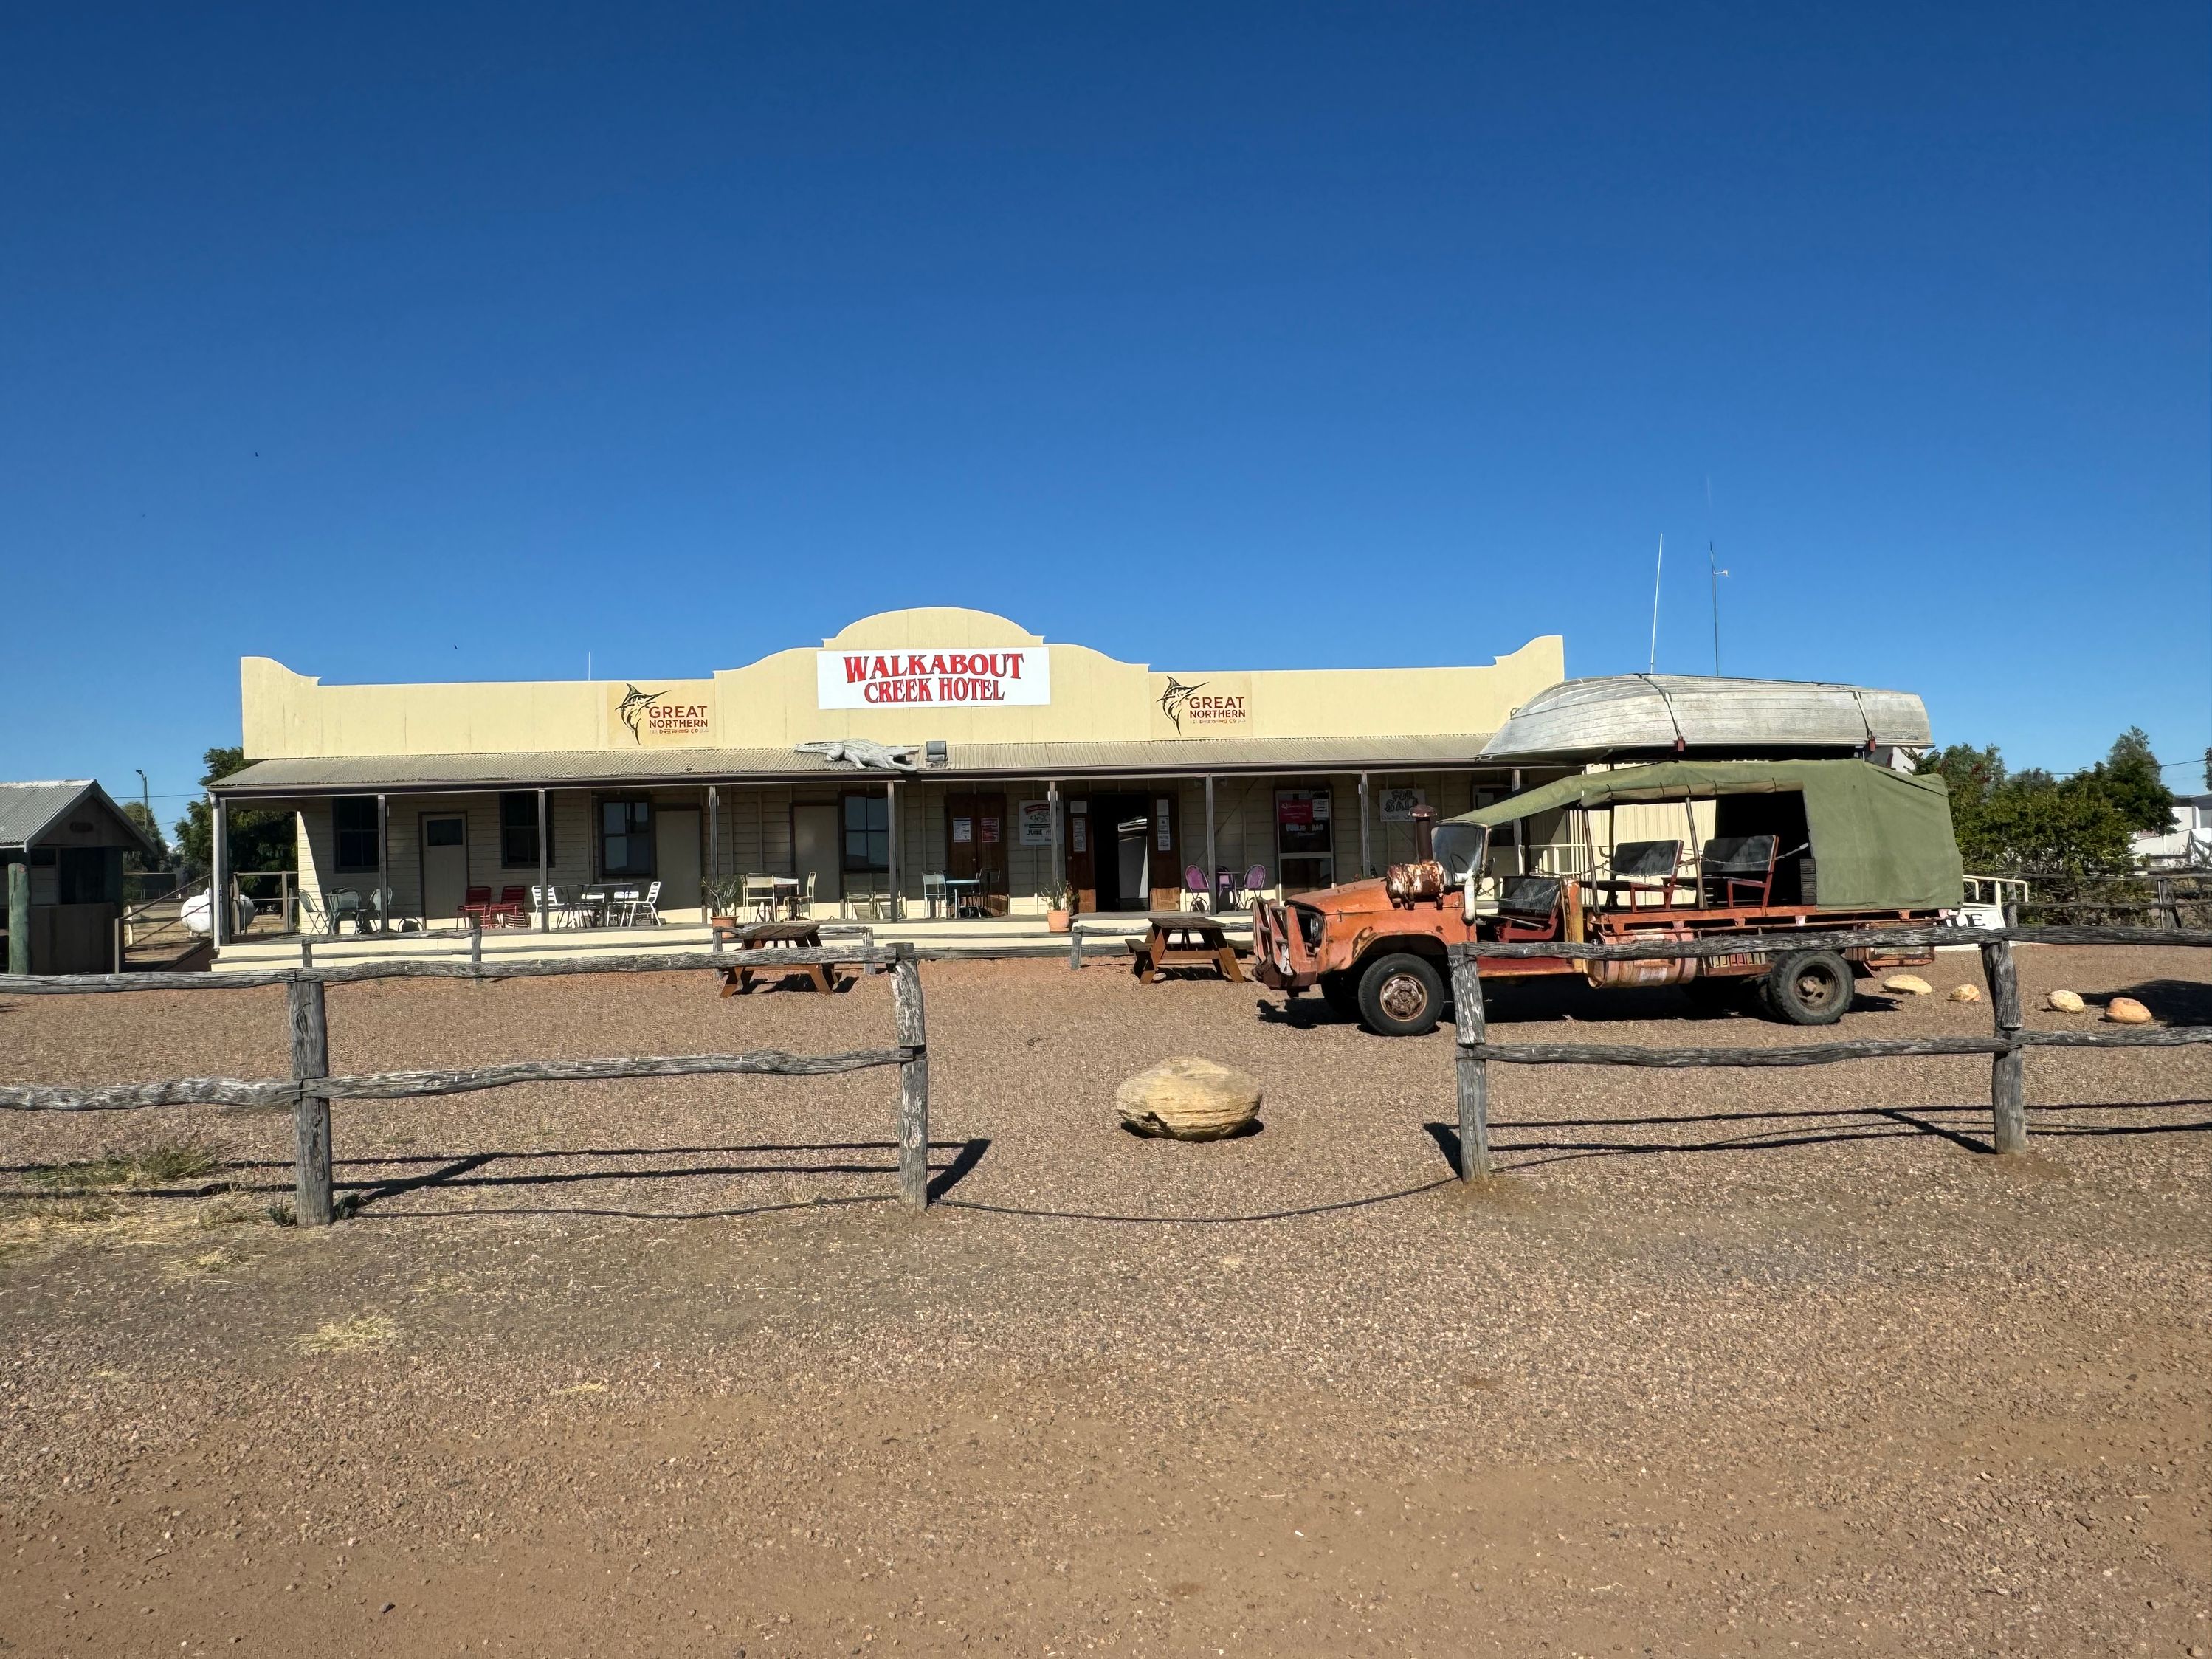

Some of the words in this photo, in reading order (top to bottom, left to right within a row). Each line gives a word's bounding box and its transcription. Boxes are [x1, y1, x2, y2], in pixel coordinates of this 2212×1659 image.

[843, 653, 1024, 683] WALKABOUT
[864, 677, 933, 703] CREEK
[938, 677, 1005, 701] HOTEL
[1189, 697, 1244, 708] GREAT
[649, 706, 707, 718] GREAT
[1190, 709, 1245, 718] NORTHERN
[649, 719, 708, 728] NORTHERN
